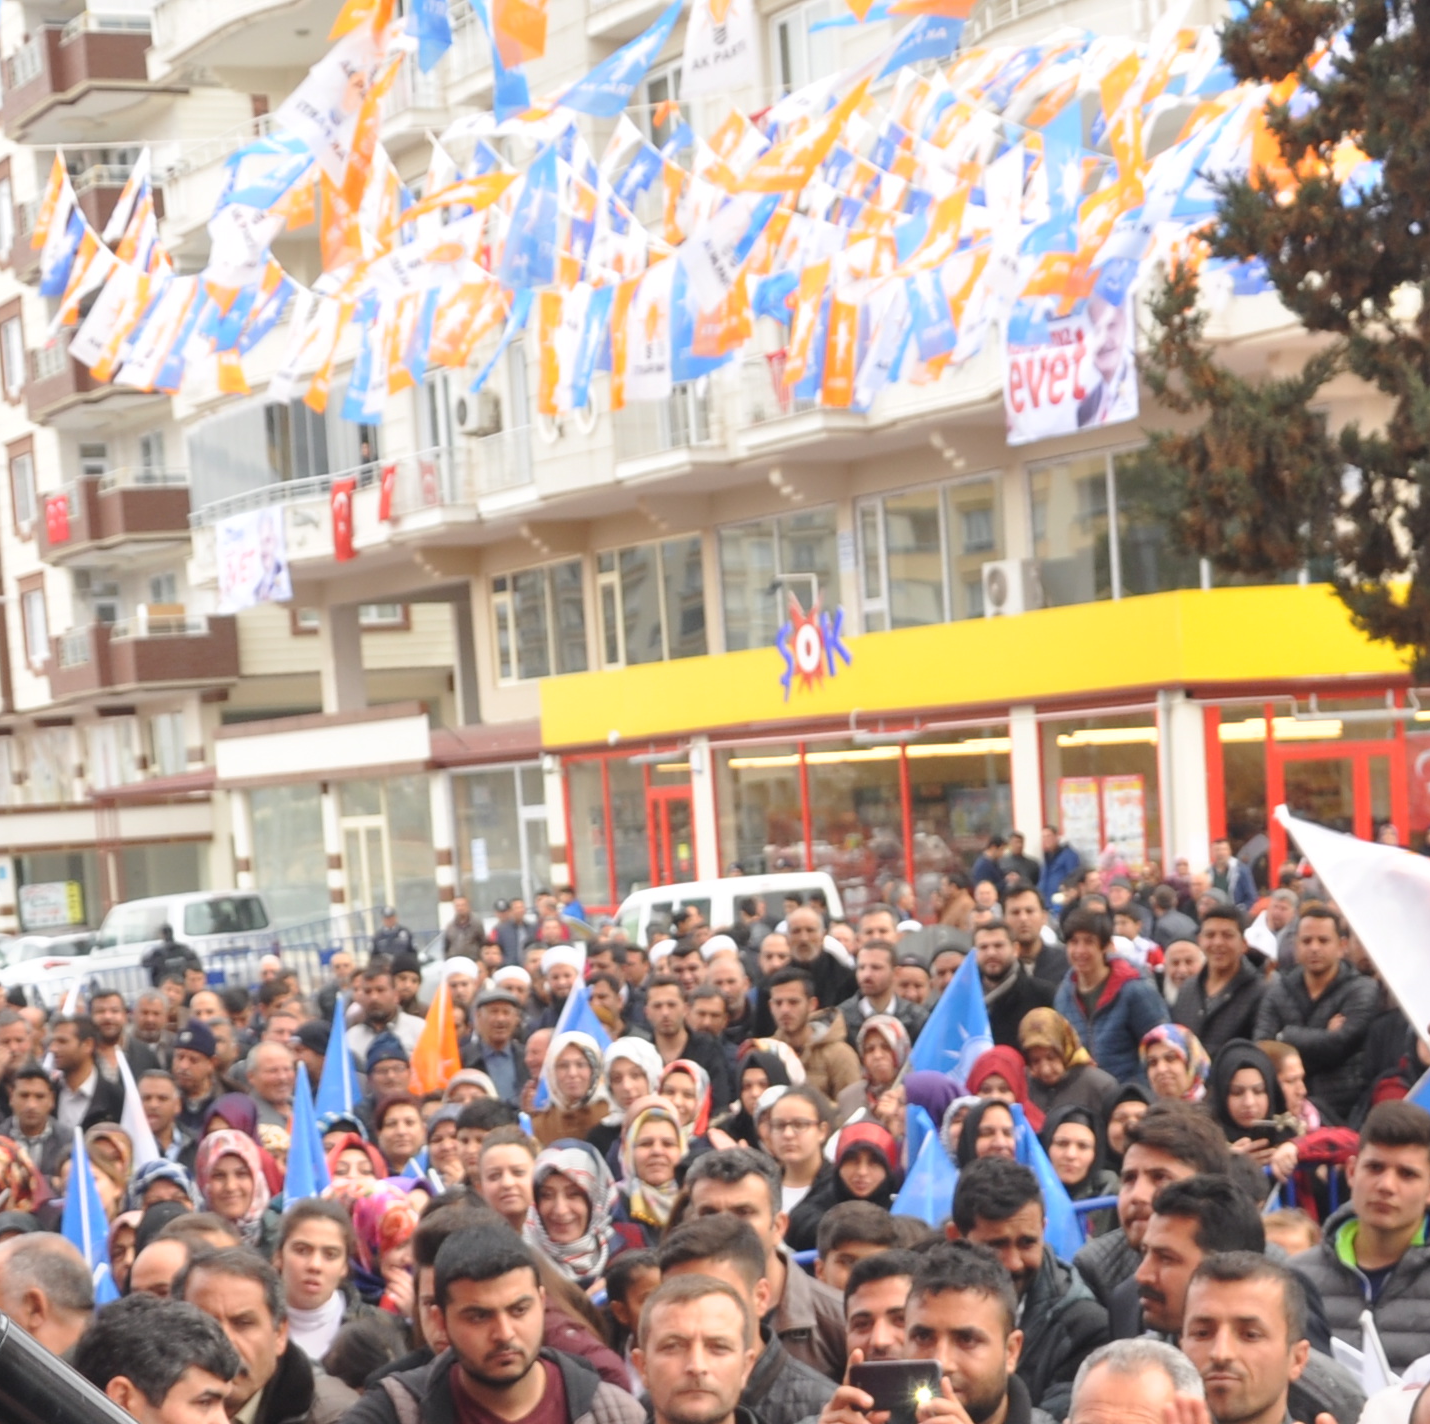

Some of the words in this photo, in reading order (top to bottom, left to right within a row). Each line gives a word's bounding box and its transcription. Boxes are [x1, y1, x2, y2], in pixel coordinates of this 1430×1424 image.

[691, 54, 710, 71] AK
[1010, 328, 1086, 413] evet
[775, 604, 853, 703] ŞOK
